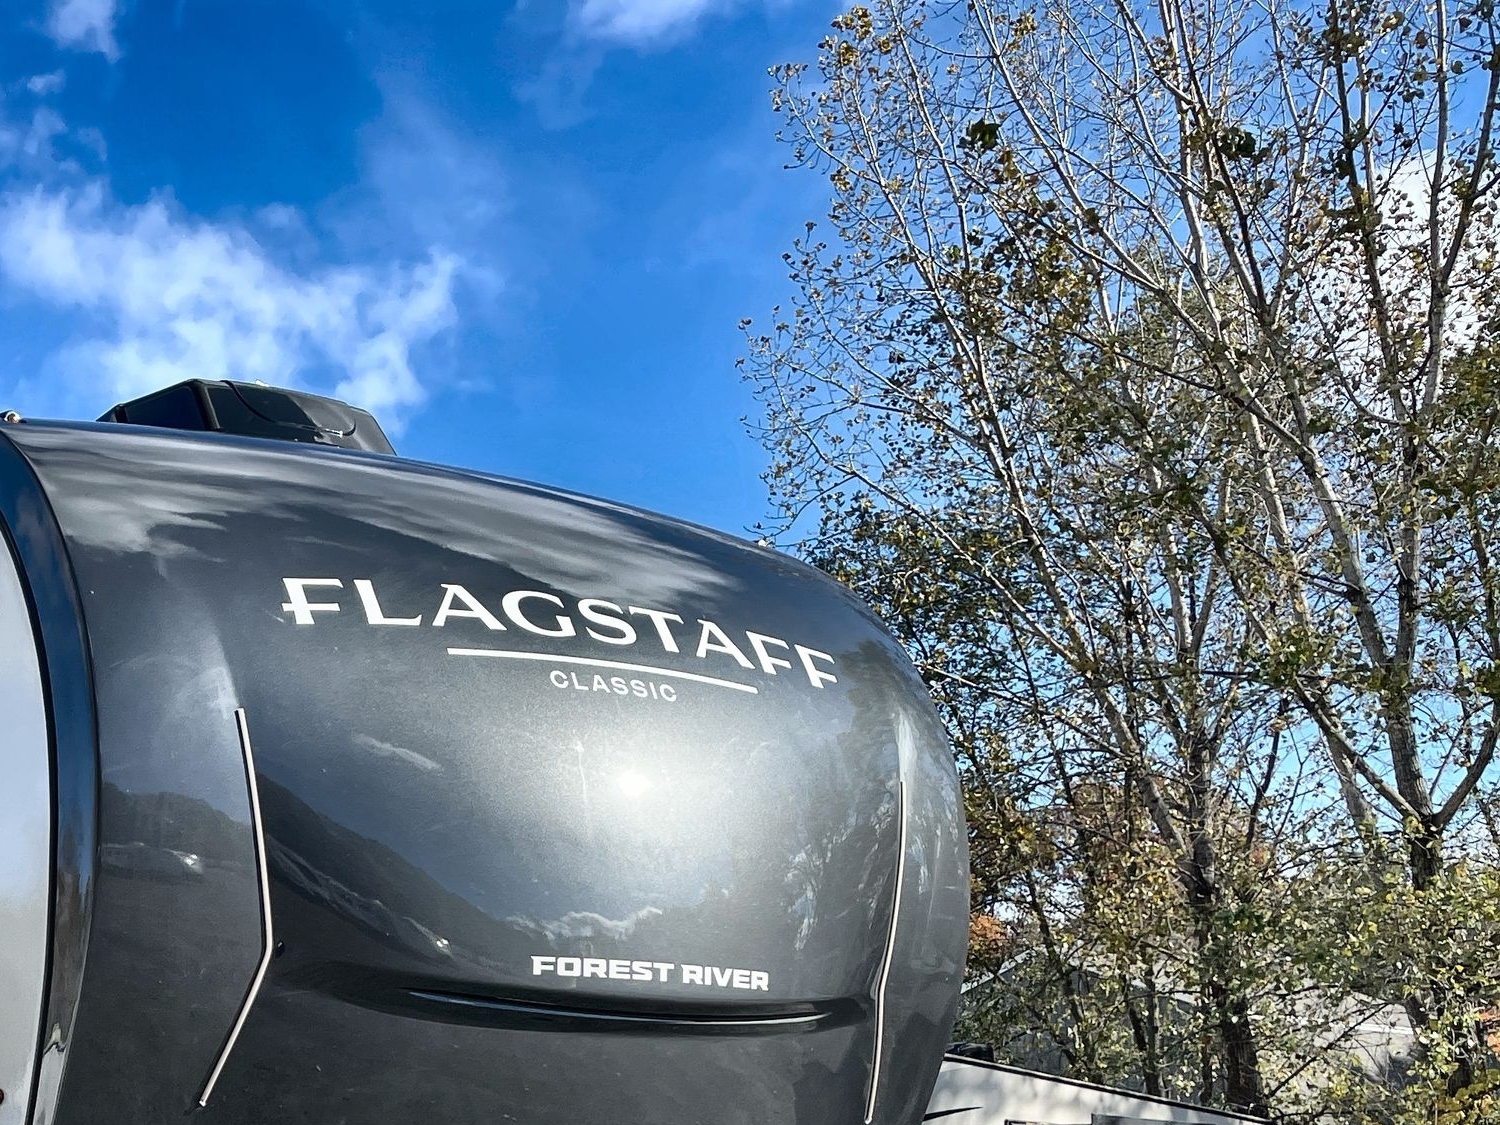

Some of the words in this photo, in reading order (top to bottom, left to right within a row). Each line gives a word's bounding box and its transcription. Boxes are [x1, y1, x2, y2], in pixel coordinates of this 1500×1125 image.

[282, 577, 838, 689] FLAGSTAFF
[549, 670, 678, 702] CLASSIC
[530, 955, 675, 982] FOREST
[681, 963, 770, 991] RIVER
